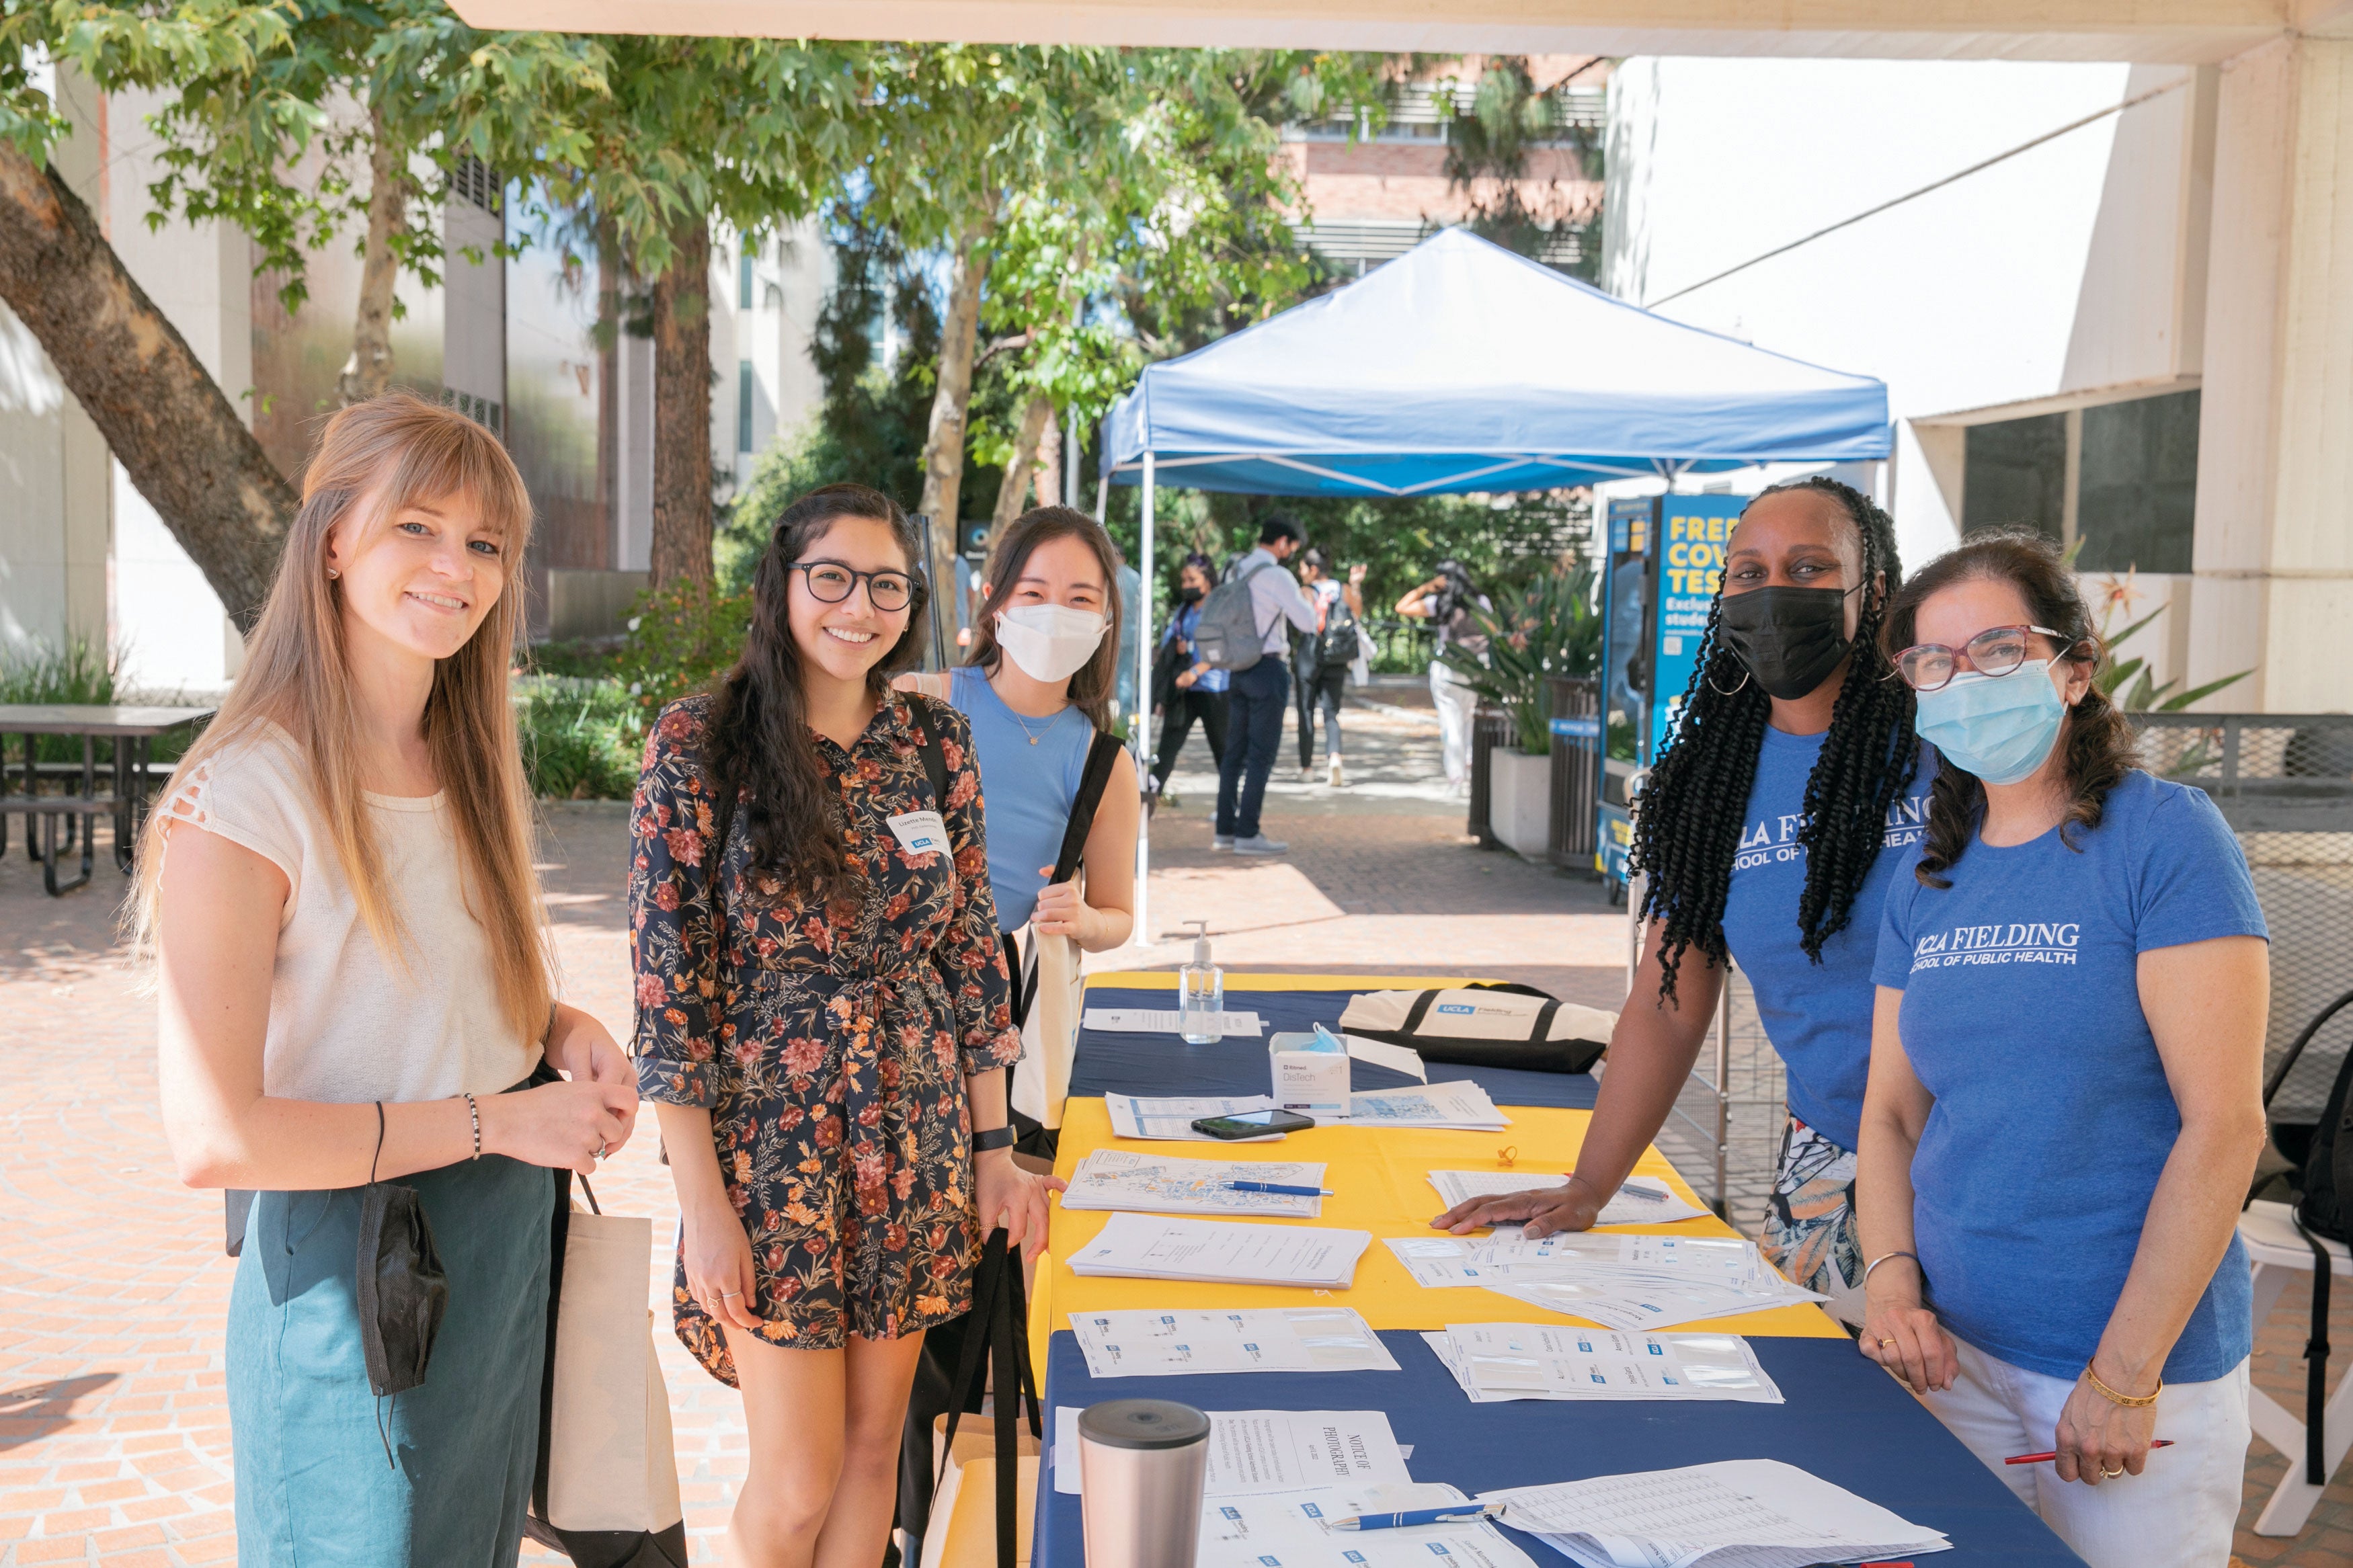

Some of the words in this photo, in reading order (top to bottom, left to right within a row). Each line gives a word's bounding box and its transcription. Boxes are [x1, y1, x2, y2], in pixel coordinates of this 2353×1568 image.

[899, 818, 919, 827] Lizette
[1776, 848, 1800, 862] OF
[1951, 923, 2079, 950] FIELDING
[1944, 954, 1960, 966] OF
[1963, 952, 2011, 966] PUBLIC
[2014, 951, 2077, 965] HEALTH
[1283, 1073, 1316, 1081] DisTech
[1651, 1345, 1660, 1354] UCLA
[1322, 1426, 1351, 1477] PHOTOGRAPHY
[1347, 1434, 1367, 1460] NOTICE
[1355, 1460, 1371, 1470] OF
[1305, 1504, 1318, 1516] UCLA
[1430, 1542, 1445, 1553] UCLA
[1648, 1542, 1659, 1556] Name
[1263, 1557, 1275, 1566] UCLA
[1347, 1551, 1361, 1561] UCLA
[1659, 1555, 1669, 1567] Last
